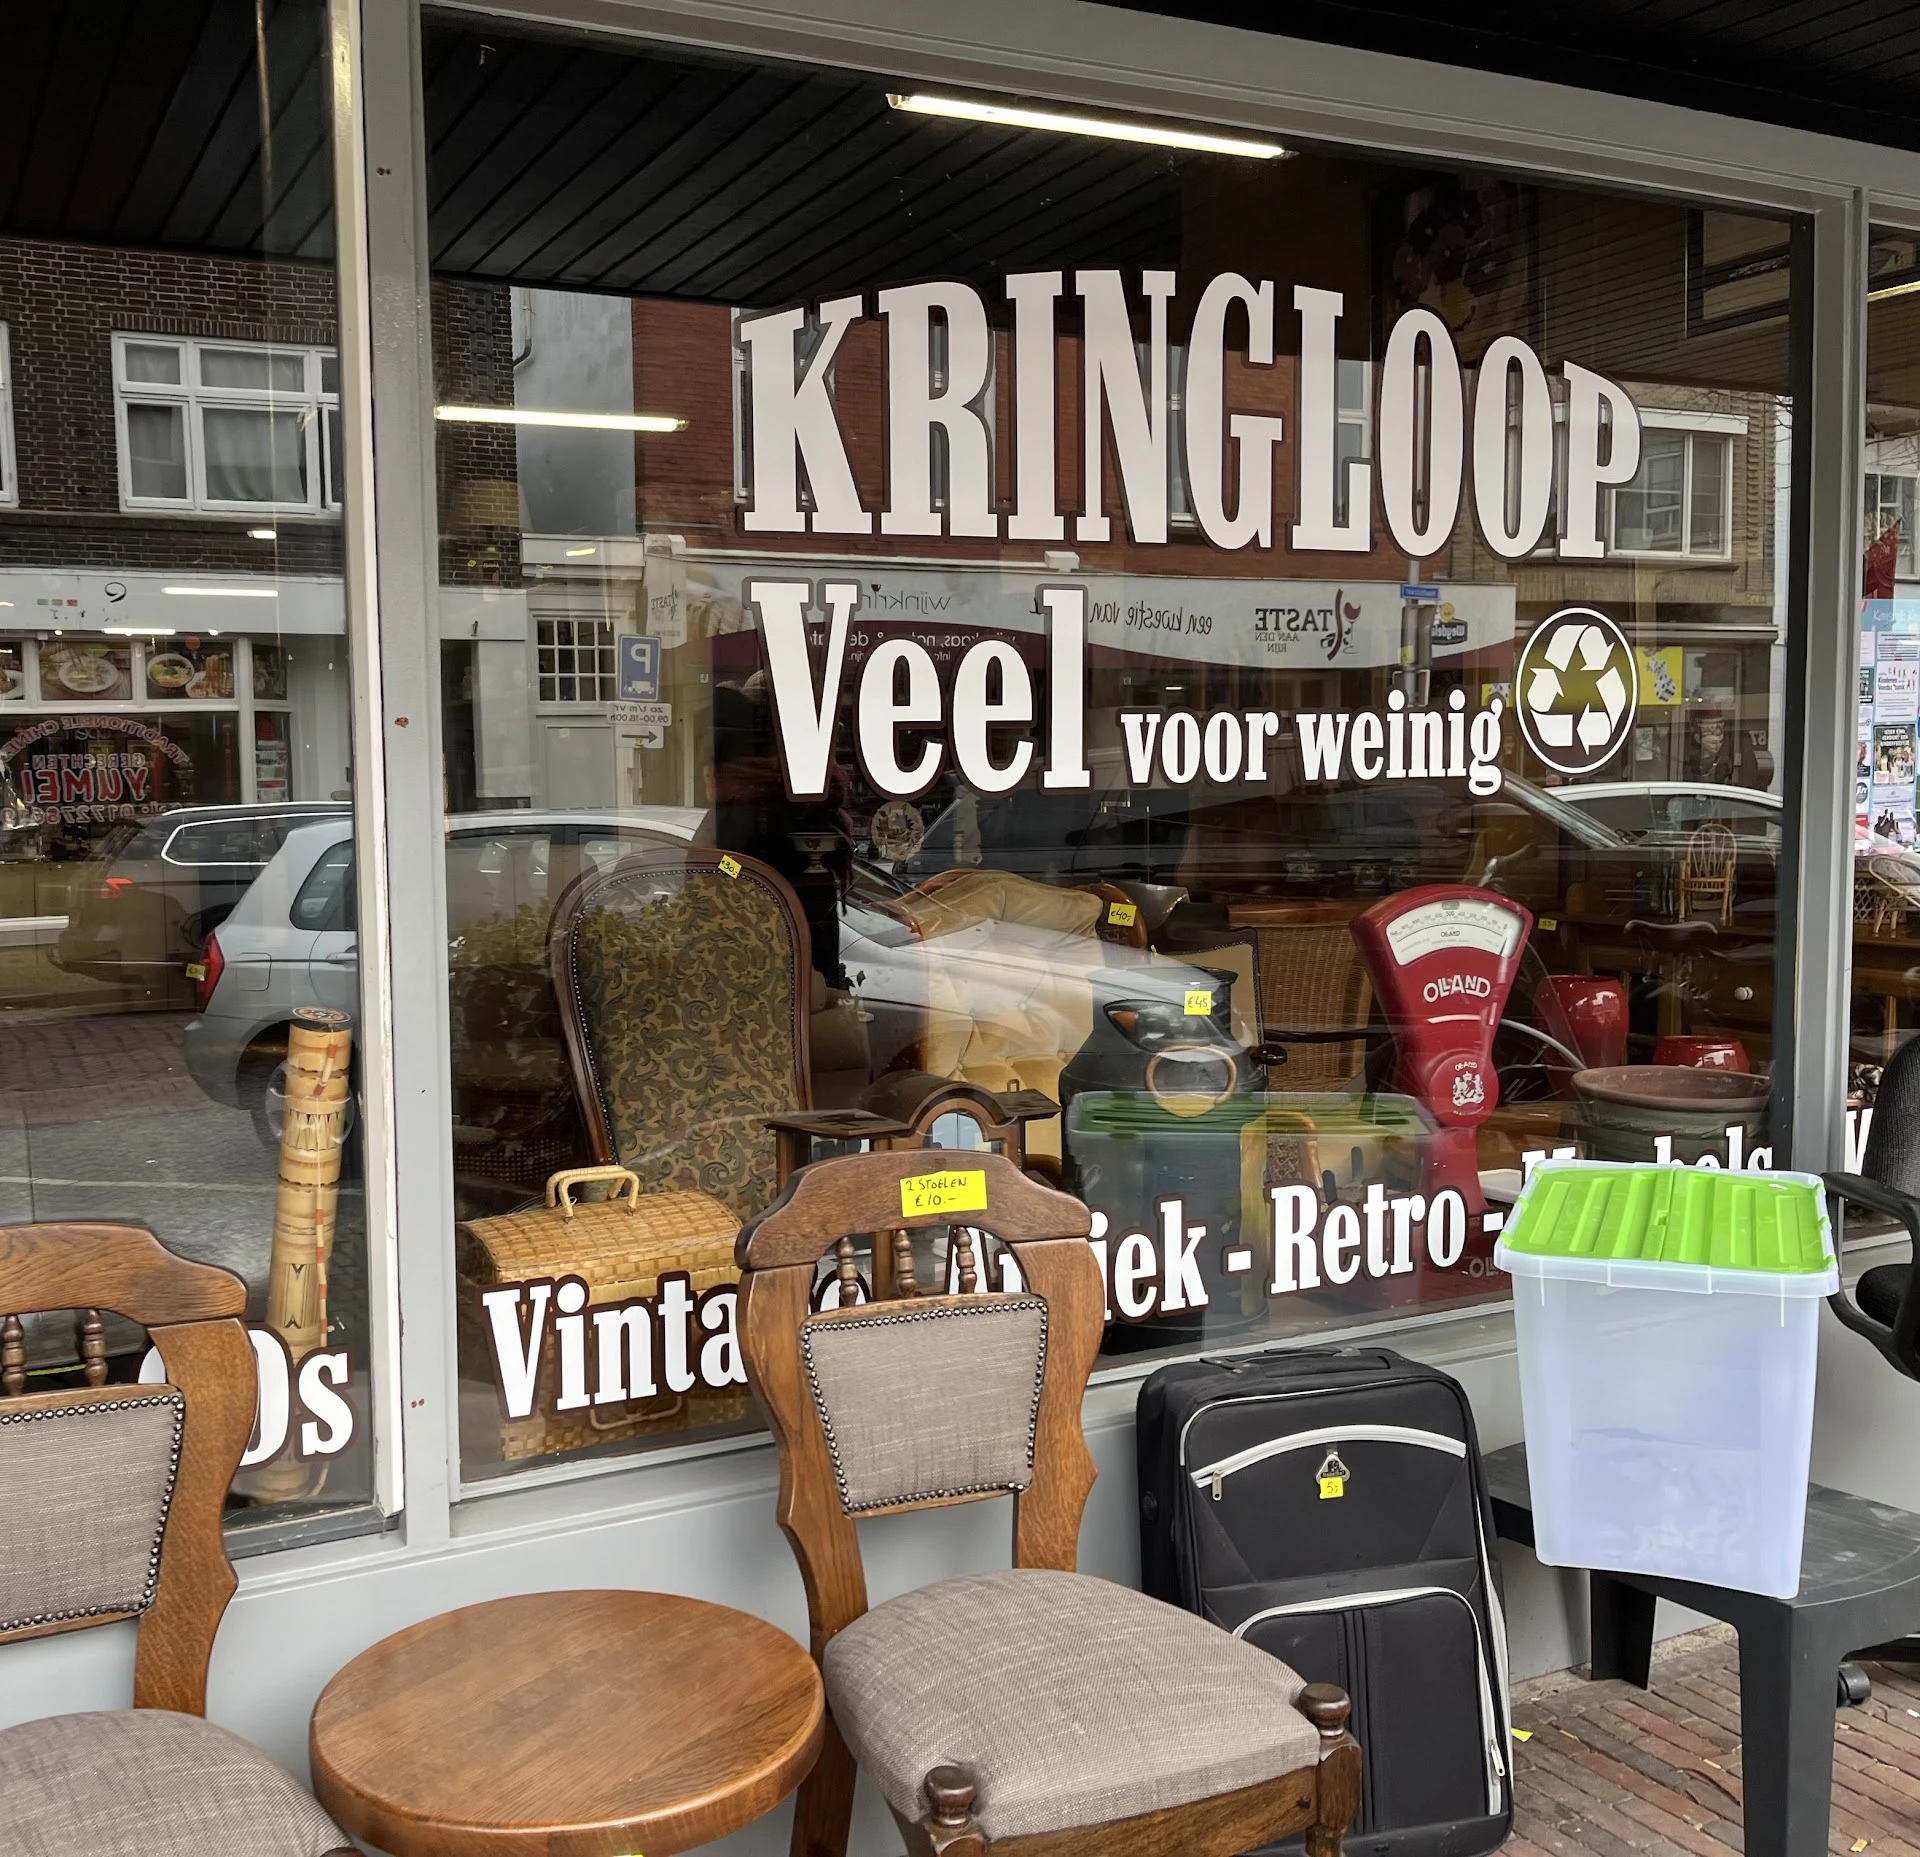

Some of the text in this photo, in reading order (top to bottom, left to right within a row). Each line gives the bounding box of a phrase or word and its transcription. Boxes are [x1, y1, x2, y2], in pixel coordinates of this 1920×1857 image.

[740, 271, 1640, 559] KRINGLOOP
[750, 582, 1503, 796] Veel voor weinig
[1423, 975, 1491, 1003] OLLAND
[905, 1176, 967, 1192] 2 STOELEN
[1271, 1183, 1466, 1295] Retro
